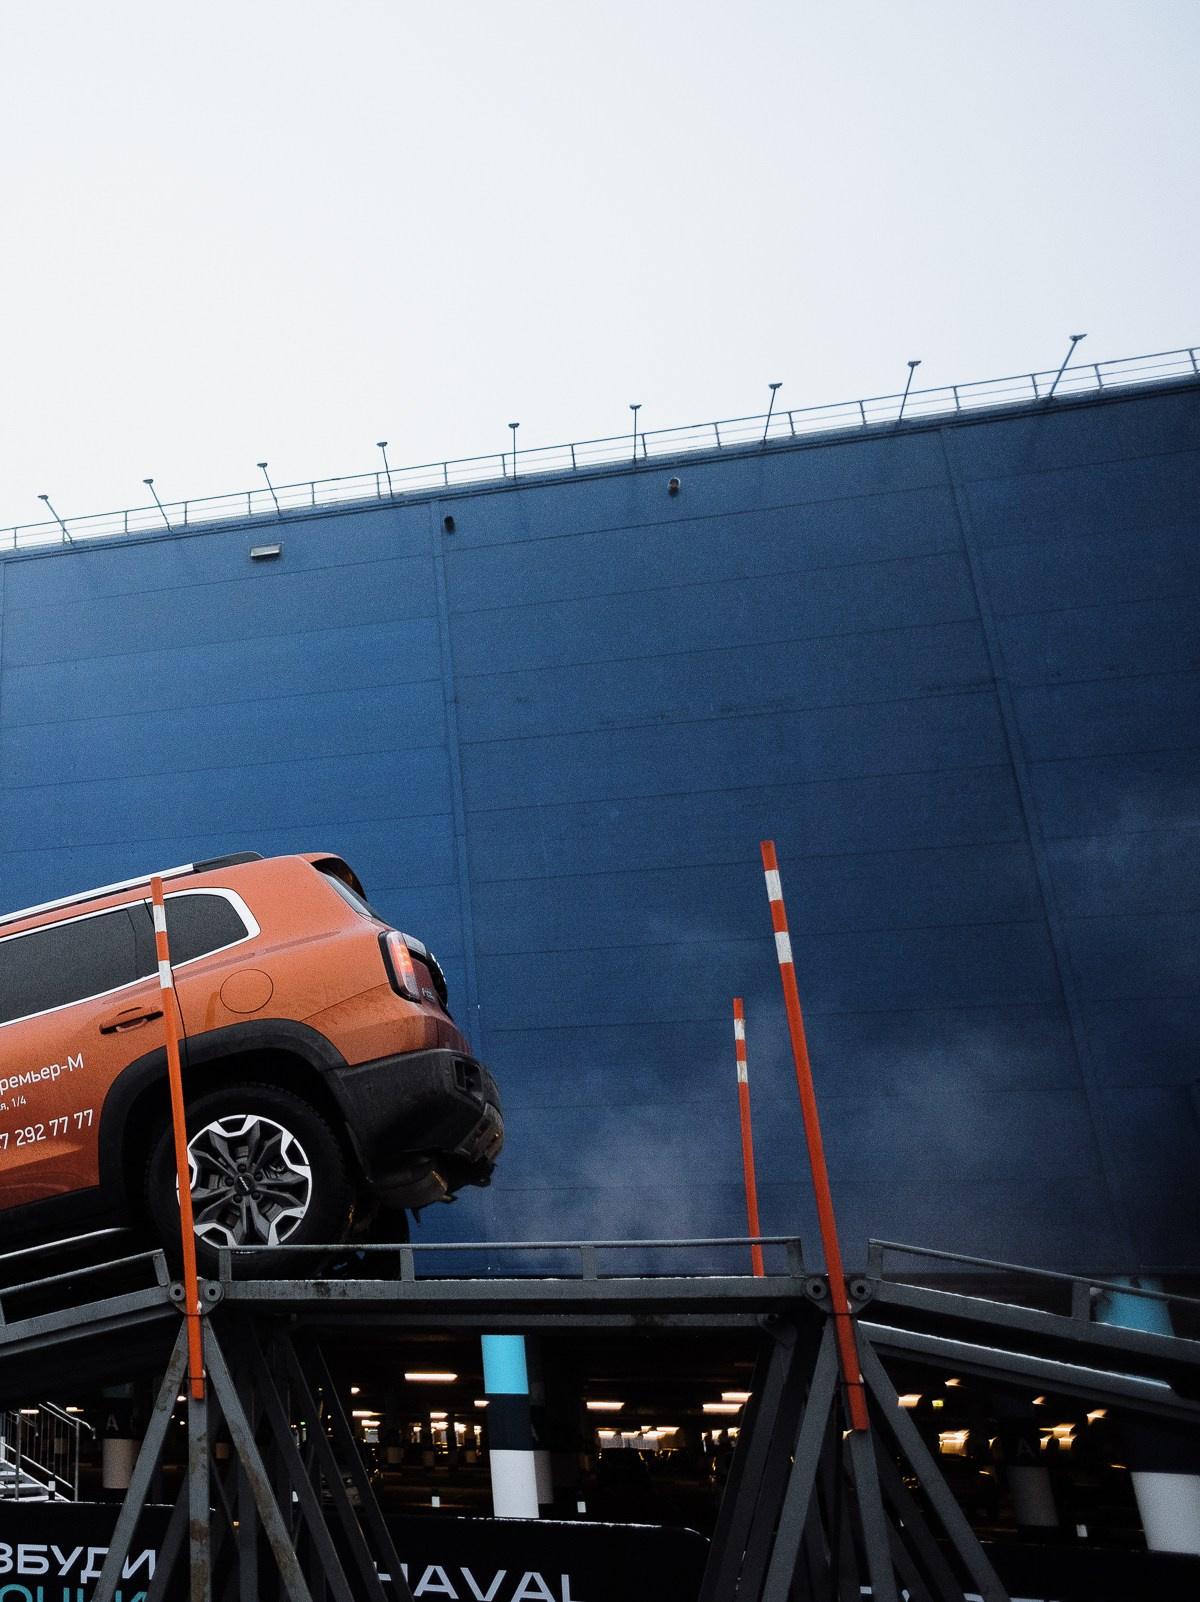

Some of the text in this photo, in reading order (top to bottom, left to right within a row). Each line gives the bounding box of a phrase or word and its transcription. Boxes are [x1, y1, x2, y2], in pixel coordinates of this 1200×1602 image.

[11, 1095, 27, 1108] 1/4
[14, 1123, 46, 1146] 292
[49, 1116, 69, 1137] 77
[73, 1109, 93, 1129] 77
